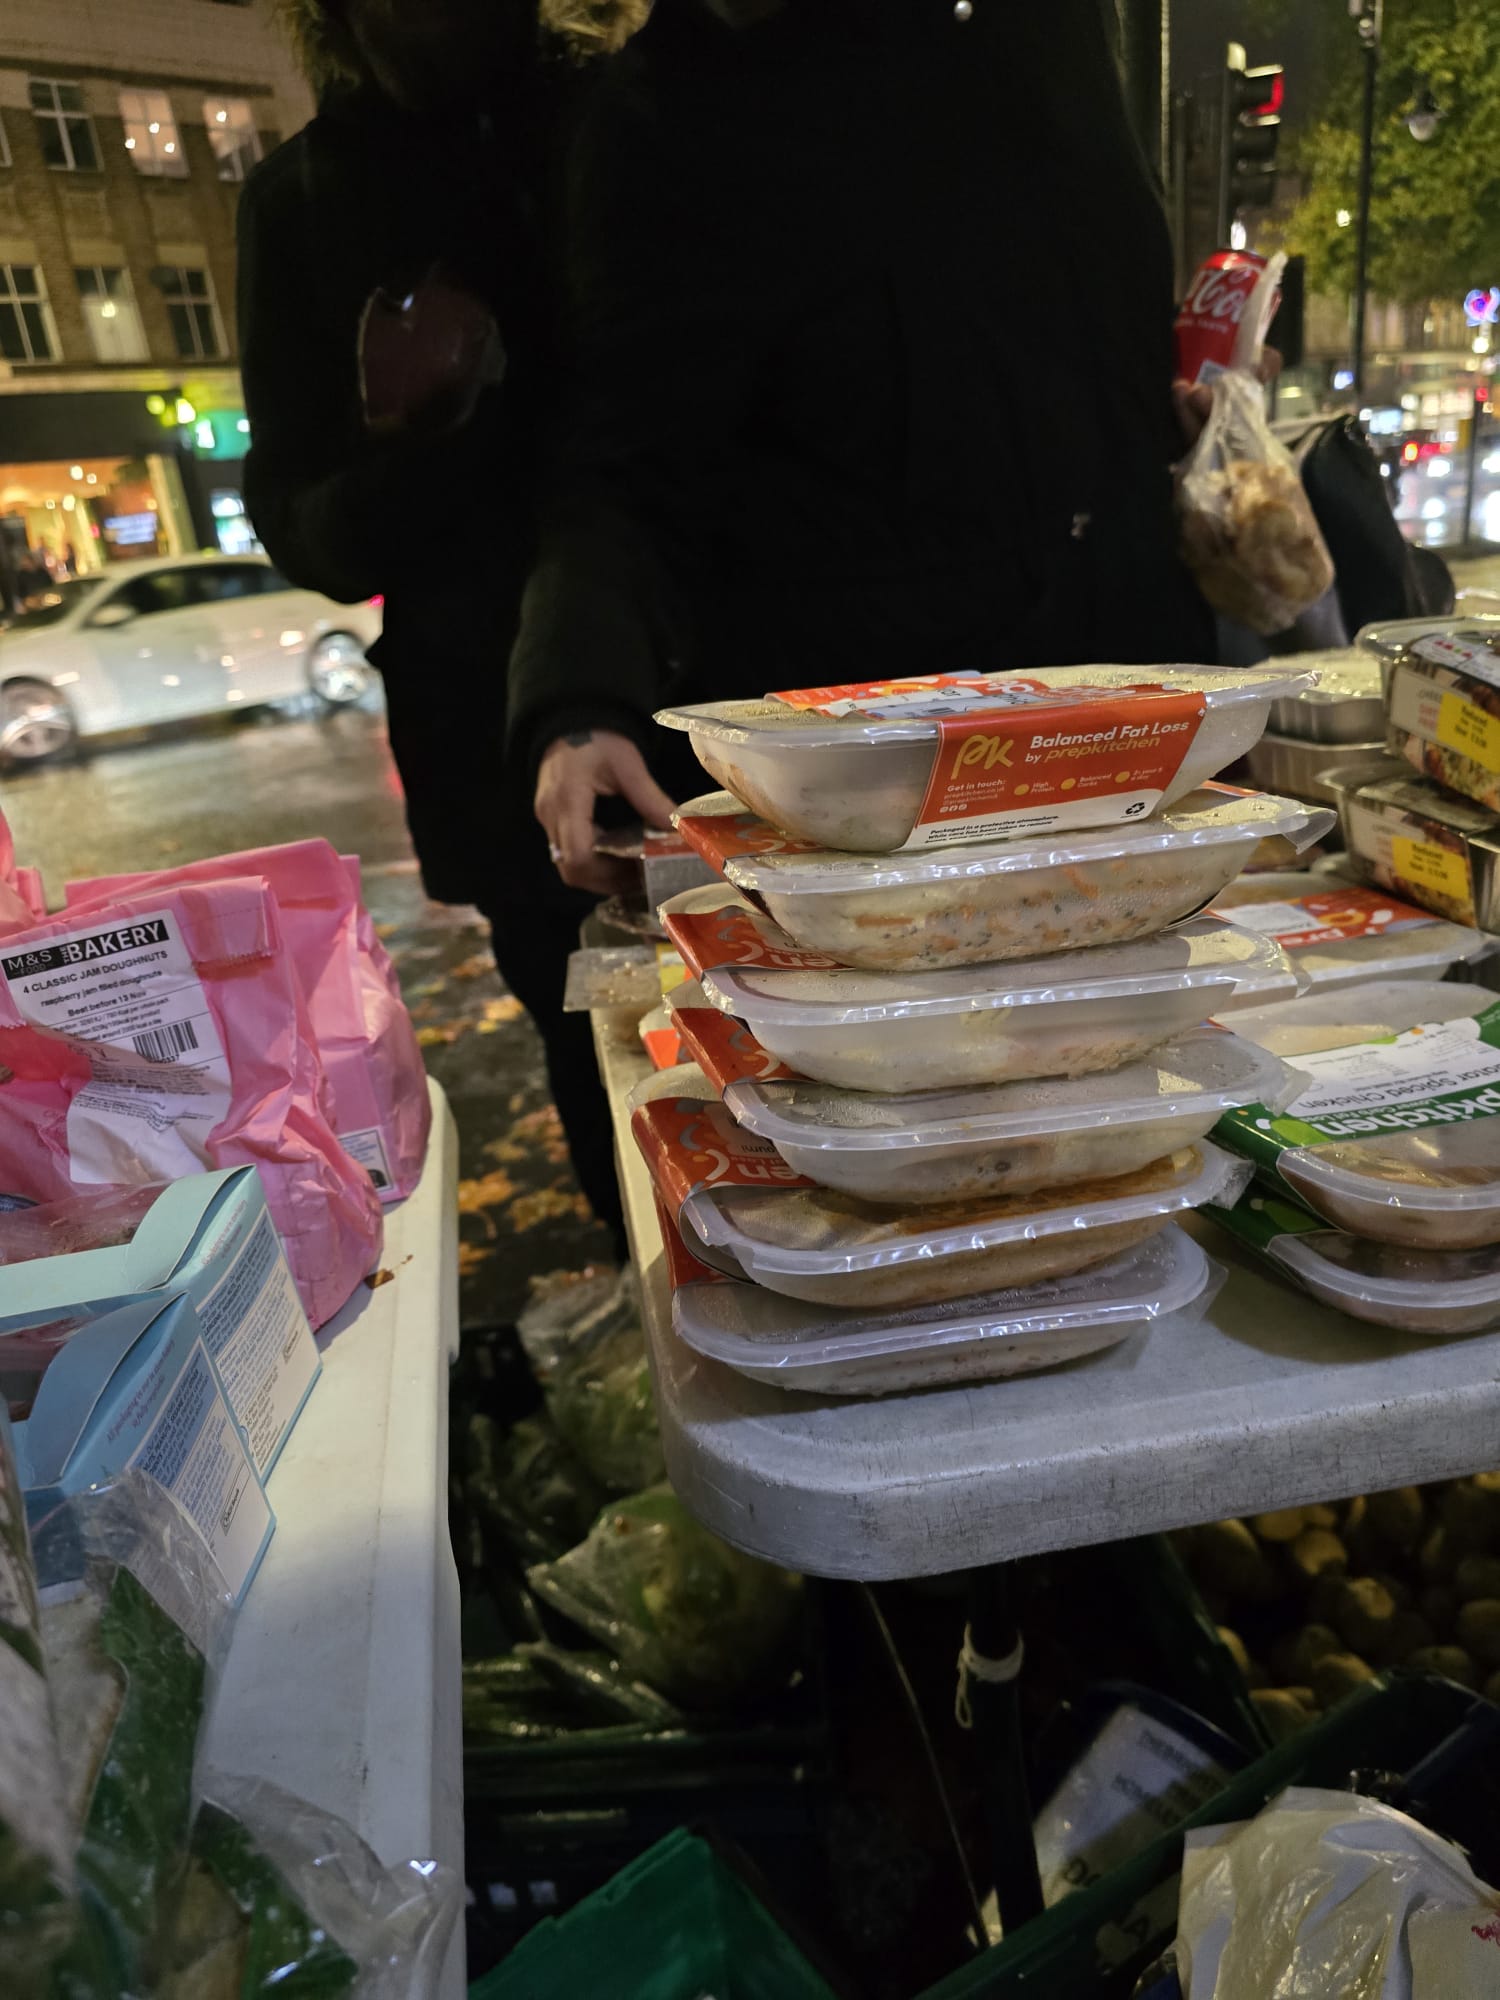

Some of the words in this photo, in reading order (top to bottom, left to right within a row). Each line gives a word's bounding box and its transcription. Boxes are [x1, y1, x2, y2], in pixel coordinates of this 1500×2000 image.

[1031, 727, 1117, 749] Balanced
[1119, 725, 1149, 740] Fat
[1152, 721, 1189, 735] Loss
[1025, 753, 1041, 764] by
[1044, 737, 1161, 763] prepkitchen
[947, 784, 964, 792] Get
[977, 779, 1005, 788] touch:
[931, 825, 965, 834] Packaged
[980, 820, 1015, 828] protective
[67, 922, 161, 962] BAKERY
[8, 950, 52, 970] M&S
[60, 946, 70, 963] THE
[21, 963, 46, 975] FOOD
[23, 986, 29, 994] 4
[32, 973, 78, 992] CLASSIC
[80, 967, 101, 981] JAM
[103, 950, 168, 973] DOUGHNUTS
[41, 991, 81, 1007] raspberry
[82, 986, 97, 998] jam
[99, 980, 119, 992] filled
[120, 970, 162, 988] doughnuts
[68, 1005, 89, 1017] Best
[90, 998, 117, 1012] before
[130, 990, 147, 1000] Nov
[1457, 1062, 1500, 1082] atar
[1387, 1077, 1457, 1097] Spiced
[1299, 1092, 1385, 1109] Chicken
[1399, 1097, 1439, 1110] Lower
[1333, 1109, 1359, 1120] Fat
[1360, 1104, 1397, 1118] Carb
